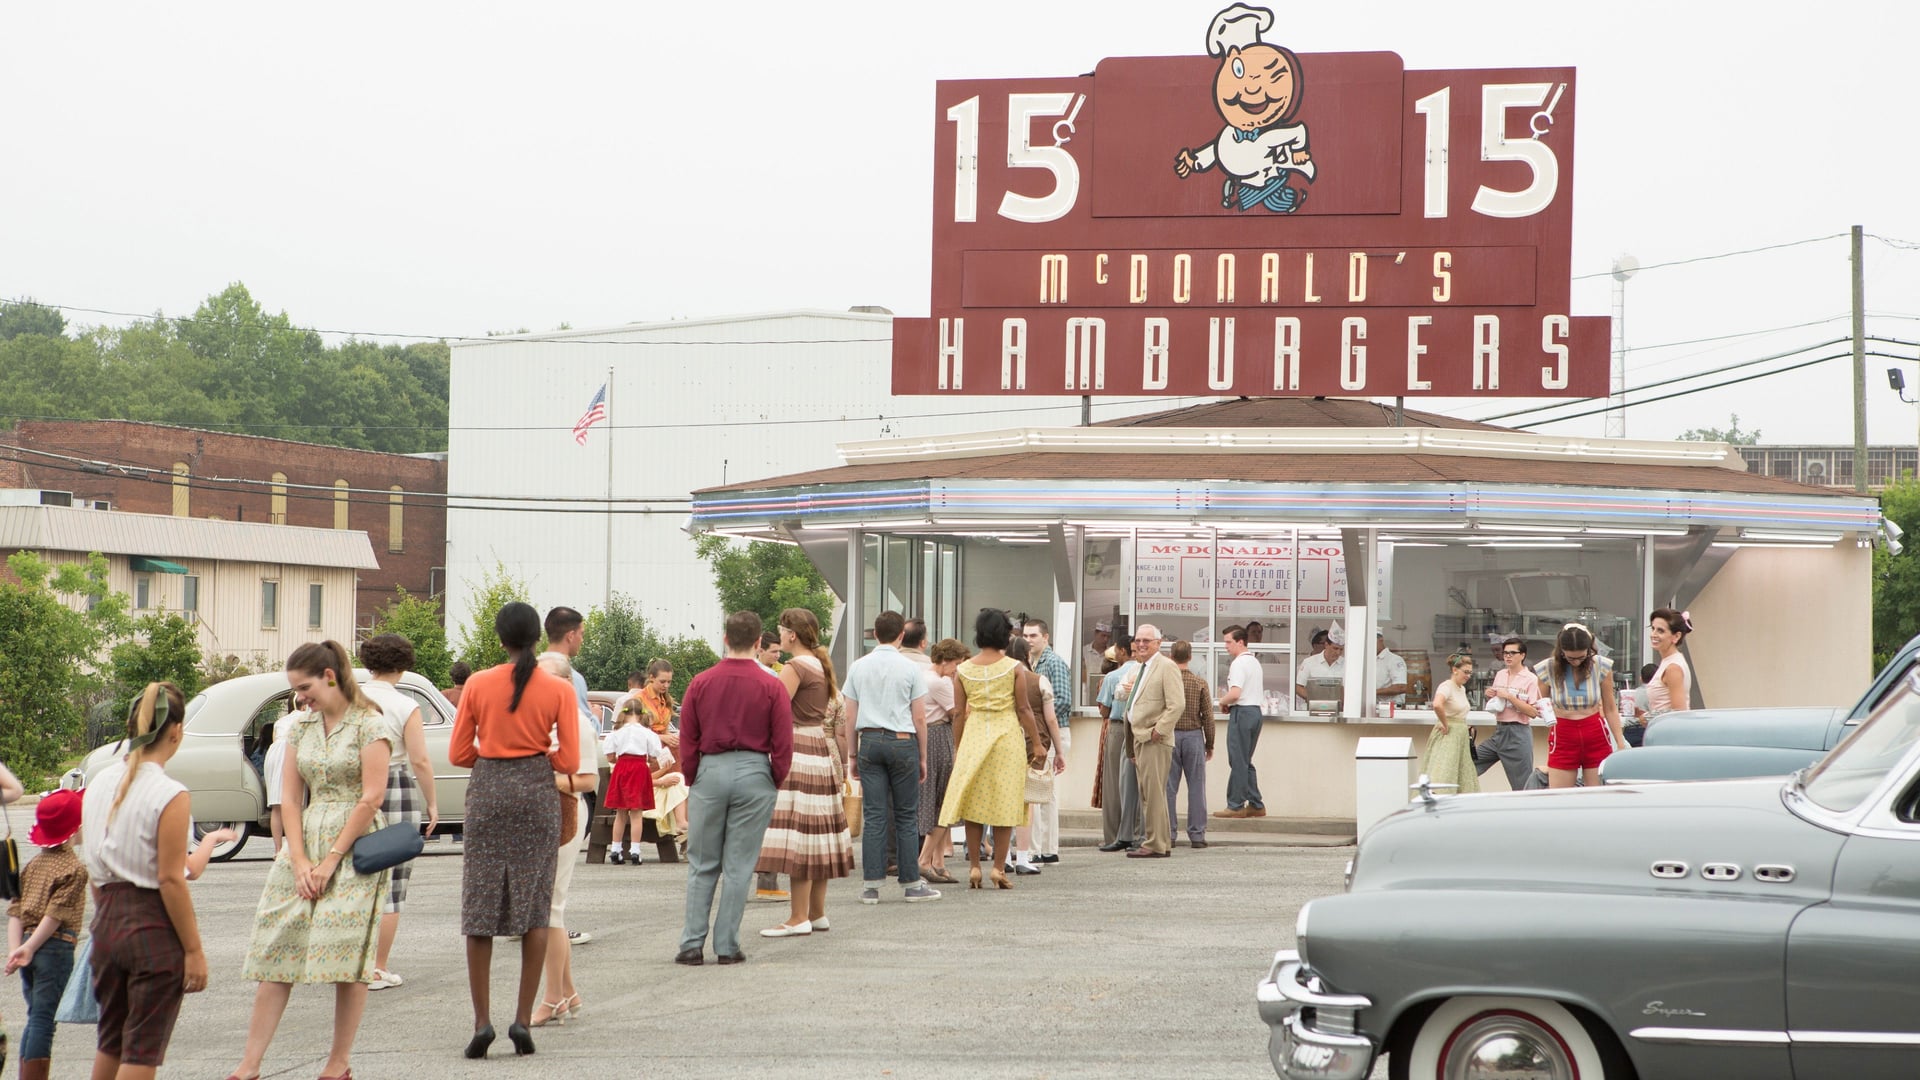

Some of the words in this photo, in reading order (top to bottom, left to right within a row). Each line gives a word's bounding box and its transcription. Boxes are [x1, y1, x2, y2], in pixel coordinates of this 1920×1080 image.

[937, 314, 1569, 391] HAMBURGERS
[1232, 568, 1306, 579] GOVERNMET
[1275, 580, 1302, 590] BEF
[1137, 602, 1199, 611] HAMBURGERS
[1642, 1000, 1707, 1017] Super
